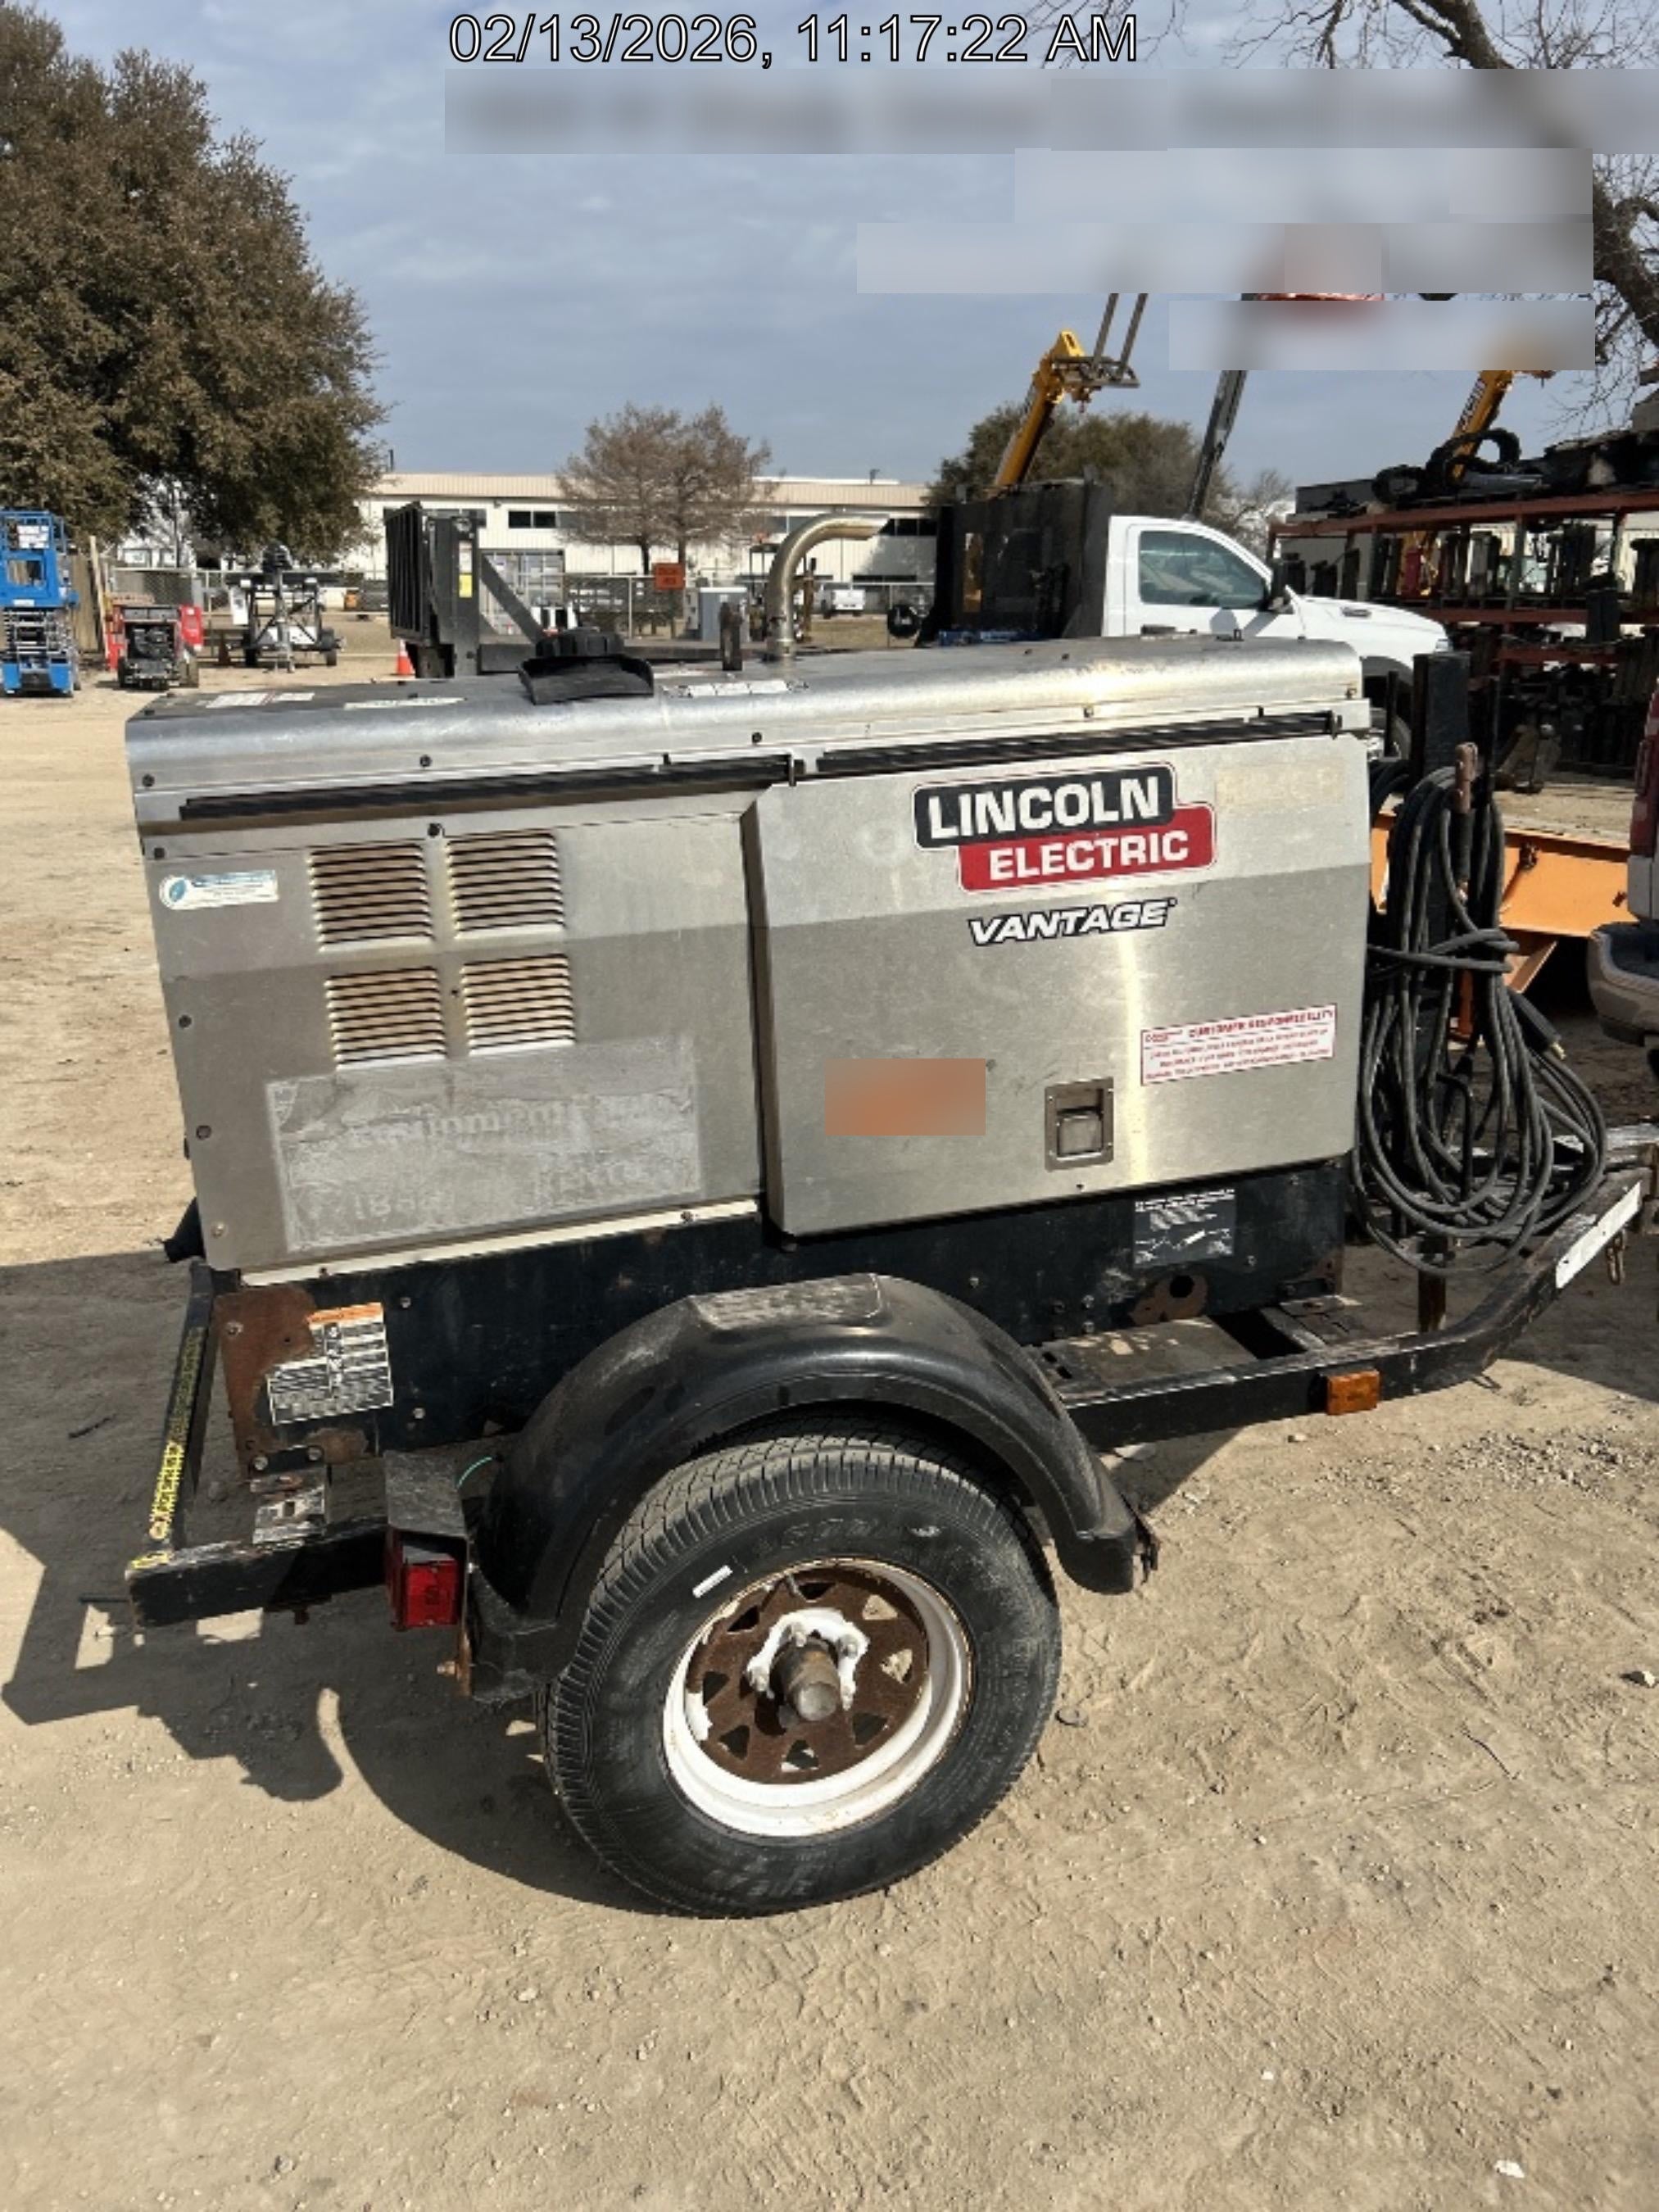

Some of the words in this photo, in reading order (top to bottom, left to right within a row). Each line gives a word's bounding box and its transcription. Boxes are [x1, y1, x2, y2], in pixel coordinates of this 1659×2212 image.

[927, 776, 1160, 840] LINCOLN
[989, 830, 1190, 881] ELECTRIC
[968, 899, 1170, 946] VANTAGE
